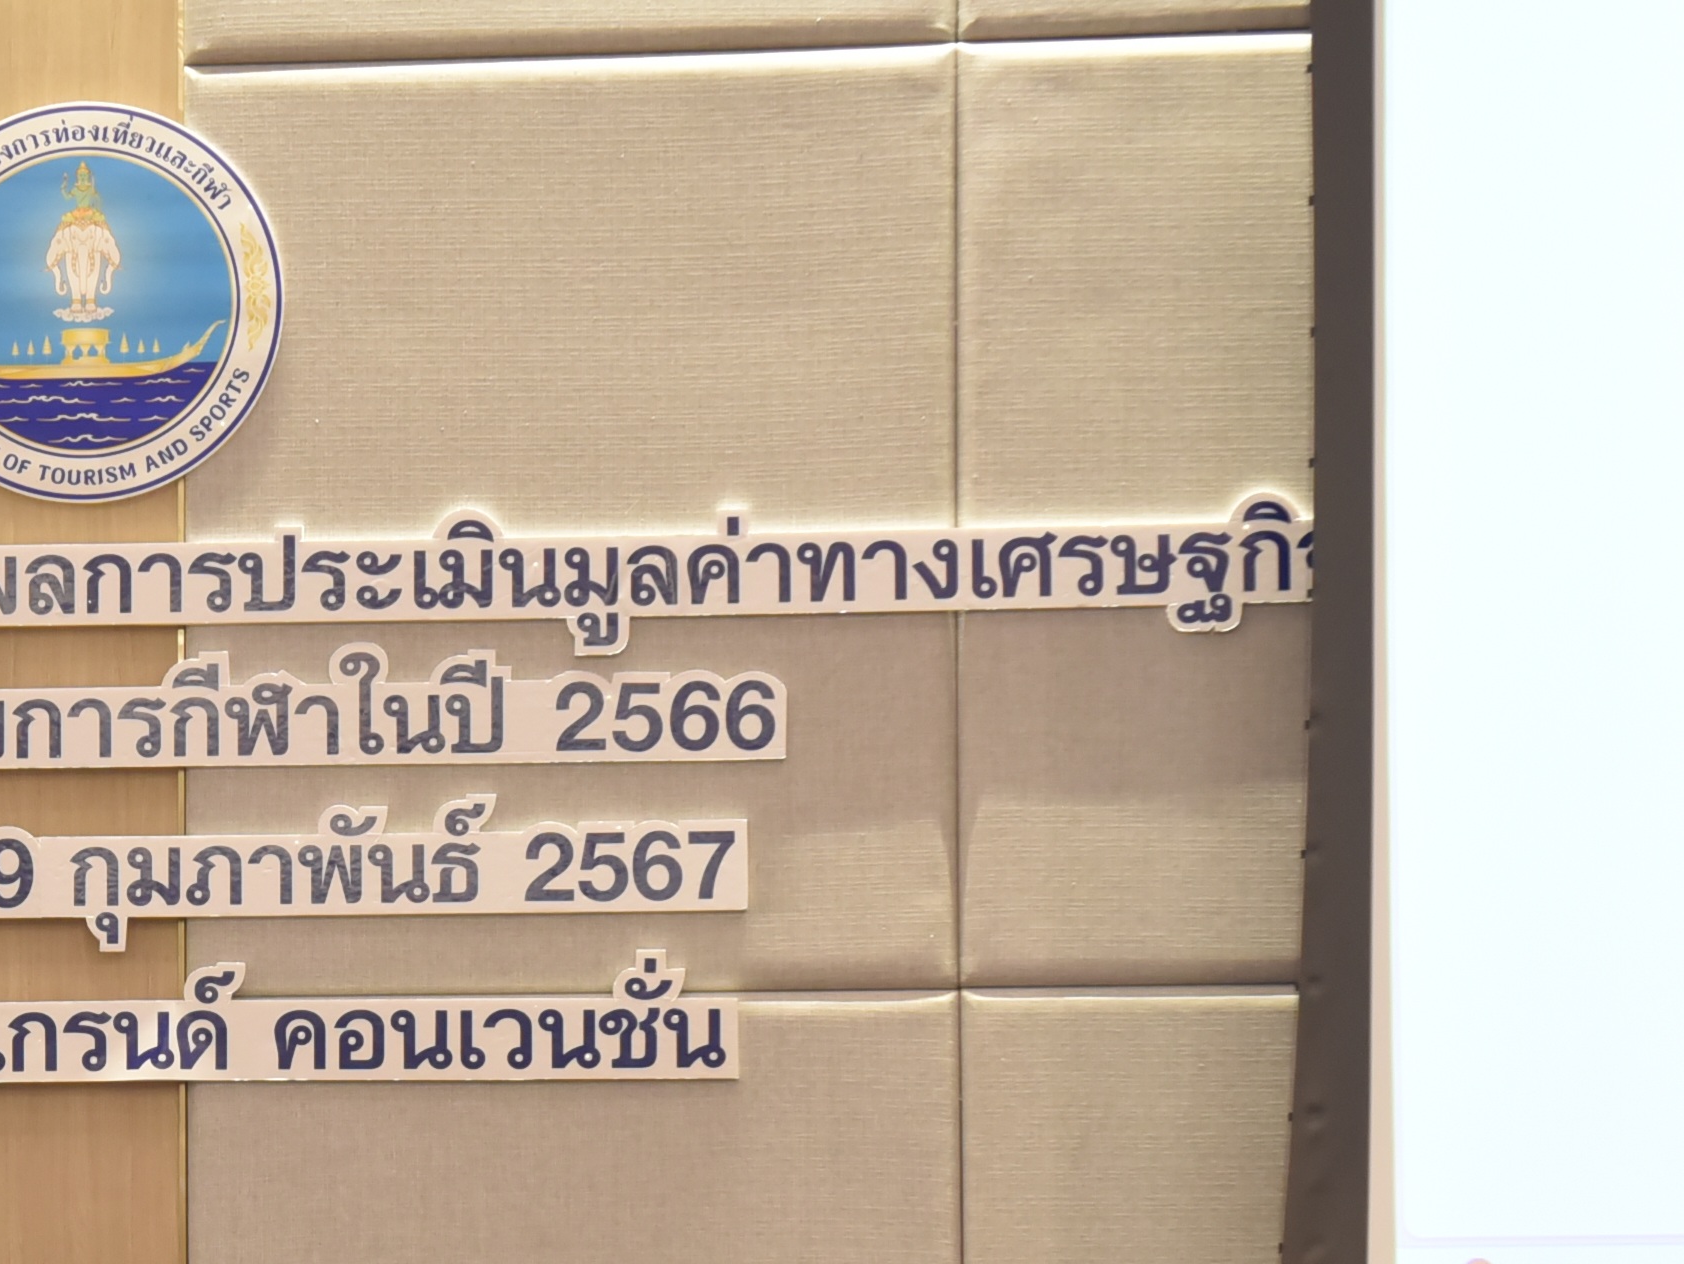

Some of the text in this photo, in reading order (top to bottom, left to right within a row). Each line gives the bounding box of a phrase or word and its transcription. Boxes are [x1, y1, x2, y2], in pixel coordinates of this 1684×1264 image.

[3, 452, 32, 475] OF
[39, 462, 137, 485] TOURISM
[145, 438, 189, 472] AND
[189, 367, 251, 442] SPORTS
[554, 680, 776, 752] 2566
[69, 802, 487, 946] กุมภาพันธ์
[524, 831, 735, 902] 2567
[274, 957, 727, 1071] คอนเวนชั่น
